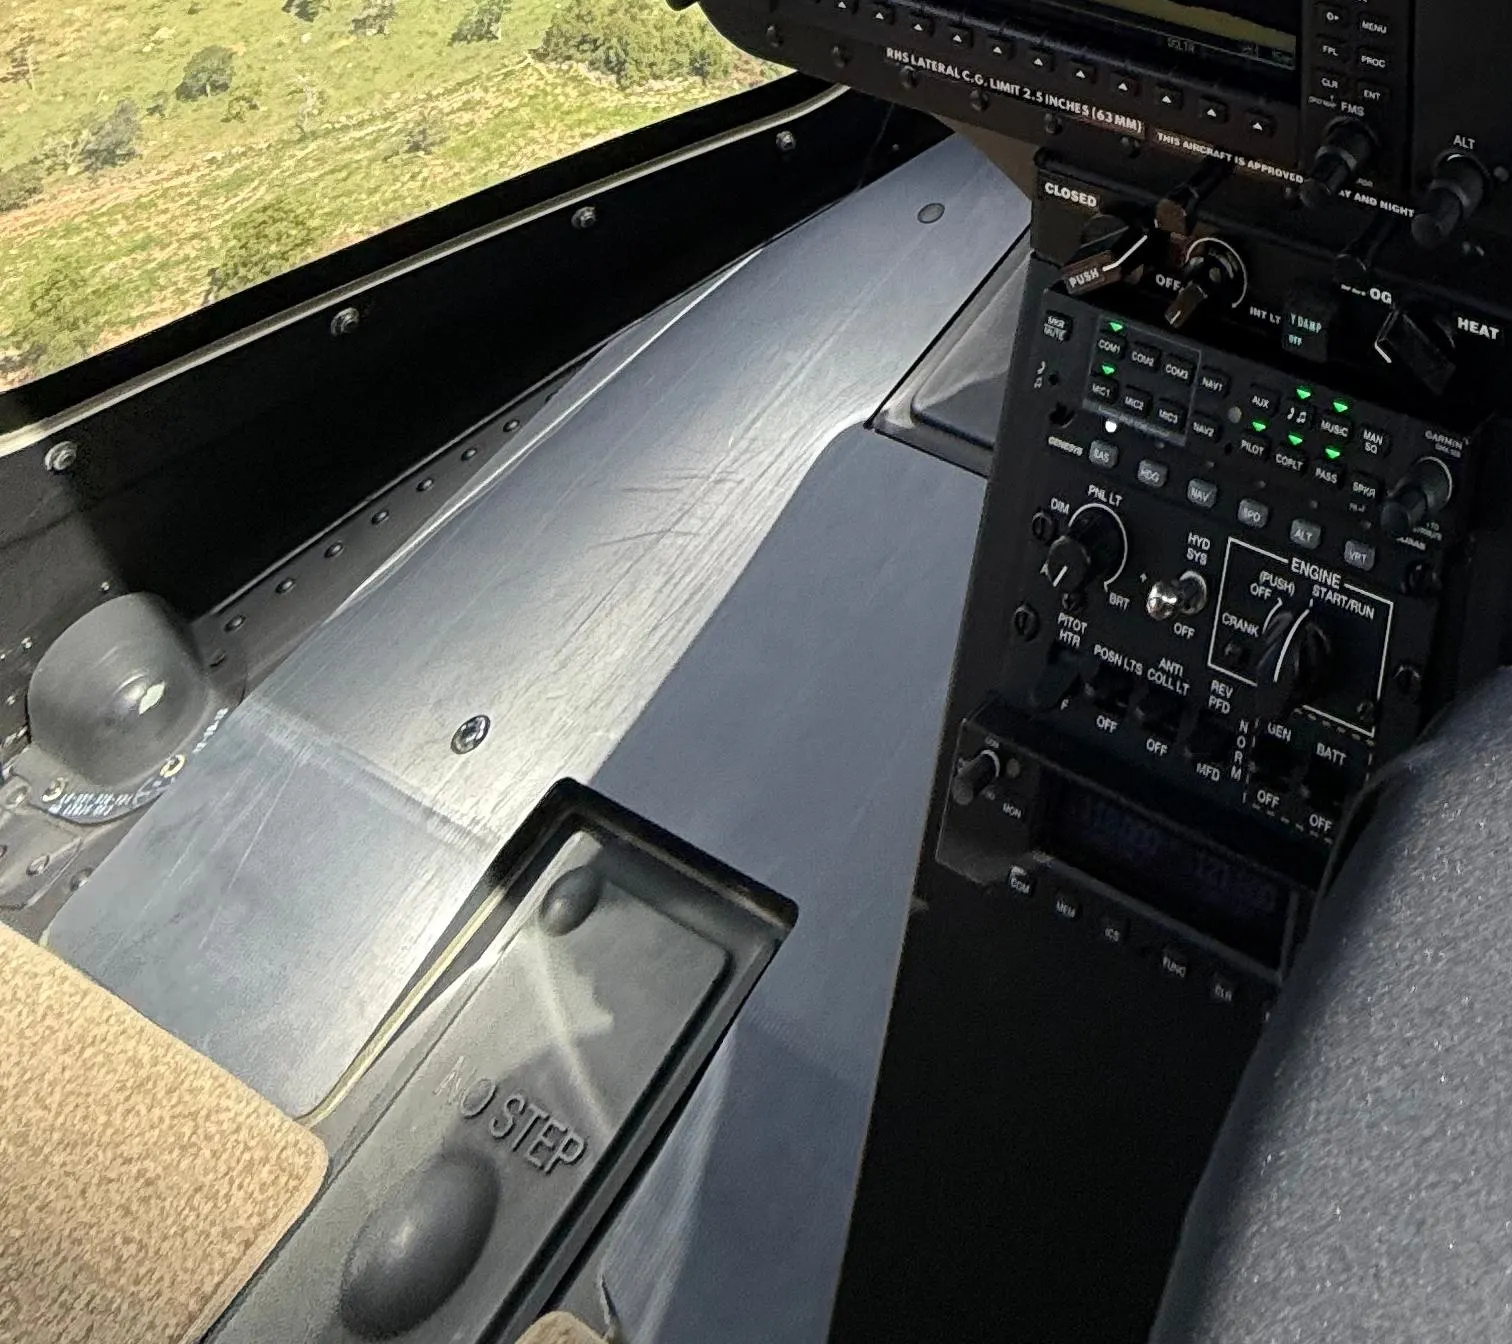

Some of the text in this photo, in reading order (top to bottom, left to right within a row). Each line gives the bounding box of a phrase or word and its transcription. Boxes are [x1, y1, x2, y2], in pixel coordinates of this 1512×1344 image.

[1361, 20, 1388, 34] MENU
[1361, 54, 1387, 68] PROC
[886, 47, 909, 63] RHS
[911, 53, 961, 79] LATERAL
[989, 76, 1020, 97] LIMIT
[1021, 86, 1043, 104] 2.5
[1044, 92, 1090, 113] INCHES
[1090, 104, 1113, 125] (63
[1114, 111, 1145, 132] MM)
[1340, 101, 1365, 116] FMS
[1452, 134, 1476, 150] ALT
[1157, 132, 1180, 148] THIS
[1182, 139, 1232, 163] AIRCRAFT
[1234, 154, 1246, 166] IS
[1247, 160, 1304, 184] APPROVED
[1354, 191, 1378, 207] AND
[1379, 200, 1415, 218] NIGHT
[1044, 182, 1097, 207] CLOSED
[1069, 267, 1100, 289] PUSH
[1250, 305, 1282, 325] INT LT
[1457, 316, 1500, 340] HEAT
[1252, 394, 1270, 409] AUX
[1321, 419, 1349, 438] MUSIC
[1363, 429, 1383, 444] MAN
[1240, 439, 1265, 456] PILOT
[1087, 484, 1123, 507] PNL LT
[1050, 497, 1070, 514] DIM
[1188, 531, 1211, 551] HYD
[1186, 549, 1208, 566] SYS
[1291, 557, 1341, 589] ENGINE
[1250, 583, 1272, 600] OFF
[1259, 570, 1295, 597] (PUSH)
[1312, 584, 1375, 621] START/RUN
[1057, 612, 1088, 635] PITOT
[1173, 622, 1195, 640] OFF
[1222, 612, 1260, 638] CRANK
[1094, 643, 1144, 676] POSN LTS
[1158, 657, 1184, 675] ANTI
[1147, 667, 1191, 697] COLL LT
[1211, 680, 1234, 698] REV
[1208, 695, 1231, 714] PFD
[1095, 714, 1118, 732] OFF
[1145, 738, 1169, 757] OFF
[1316, 742, 1347, 766] BATT
[1256, 788, 1280, 808] OFF
[1308, 814, 1333, 832] OFF
[432, 1055, 588, 1175] NO STEP
